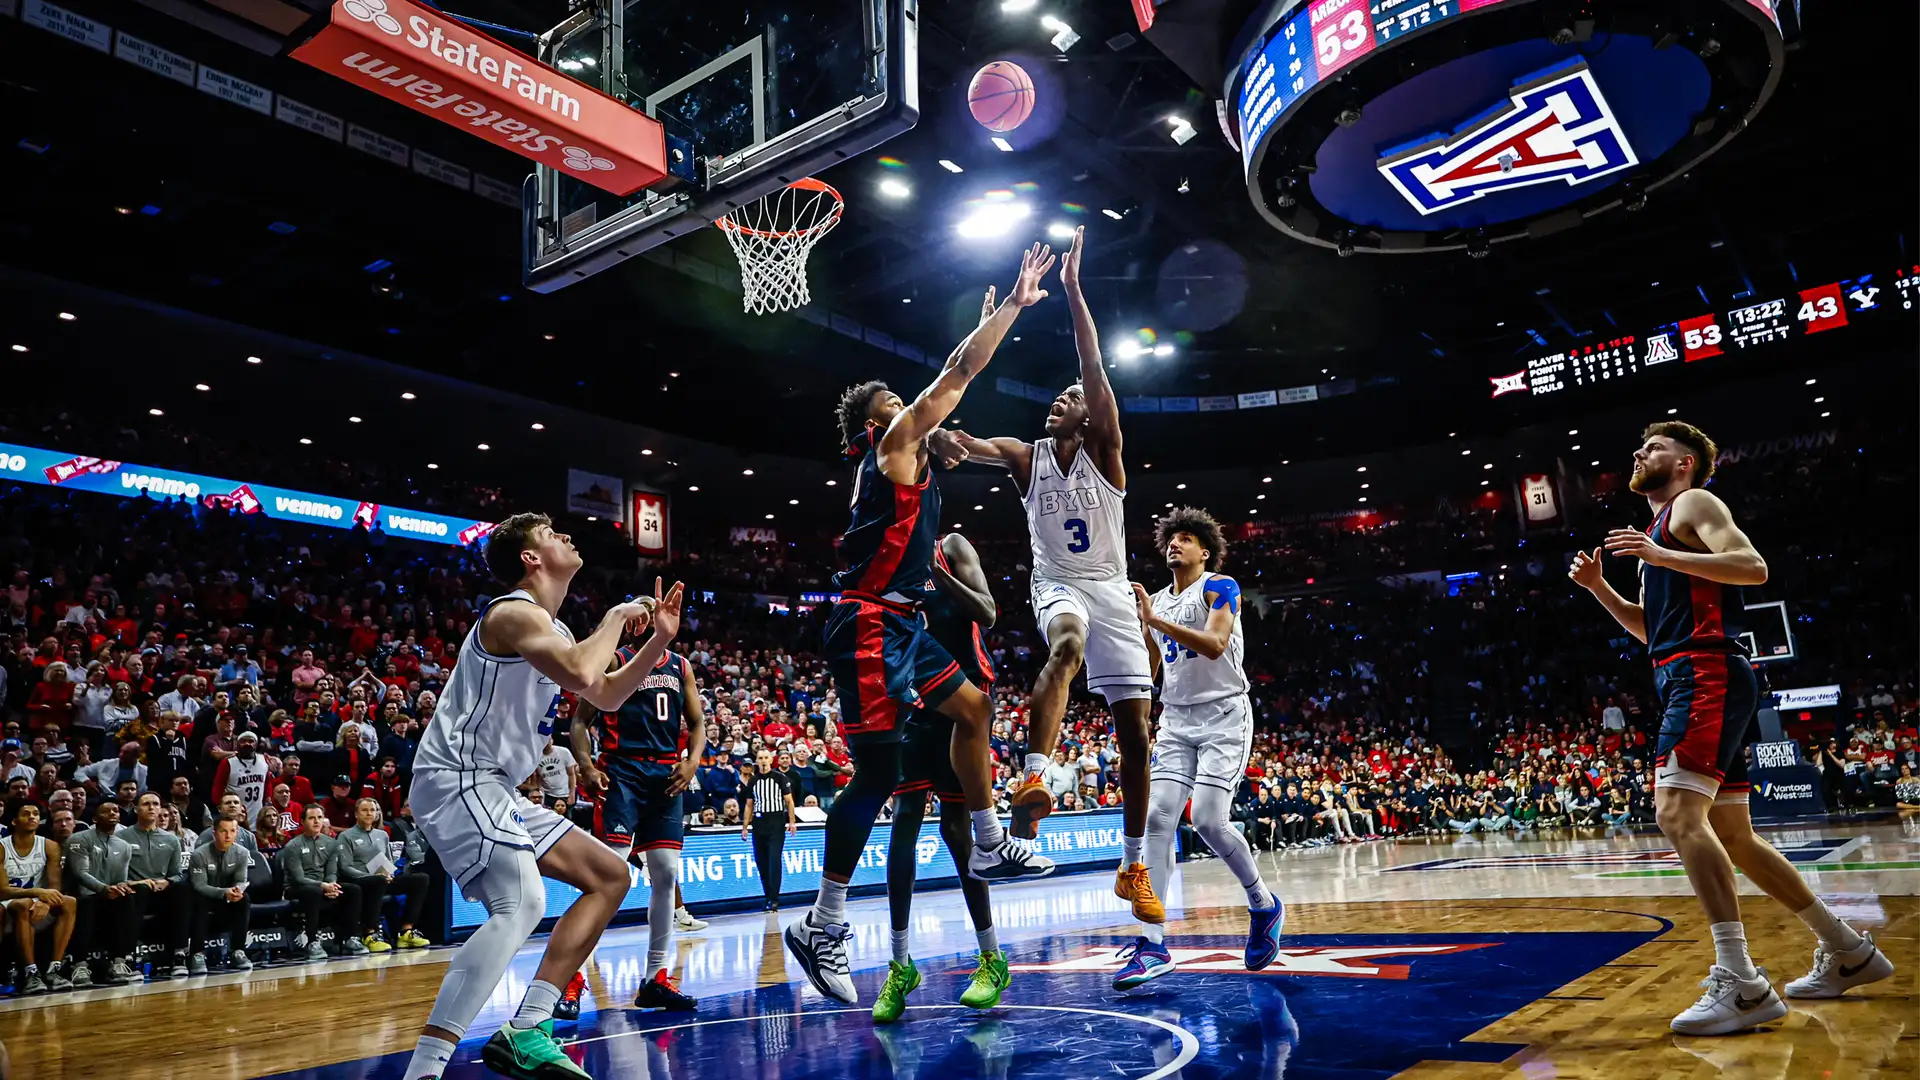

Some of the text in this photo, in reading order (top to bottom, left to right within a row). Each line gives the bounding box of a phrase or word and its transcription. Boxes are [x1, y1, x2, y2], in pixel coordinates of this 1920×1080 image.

[1285, 22, 1296, 40] 13
[1382, 4, 1448, 39] 1 3 2 1
[1317, 9, 1368, 66] 53
[1850, 287, 1880, 309] Y
[1901, 289, 1908, 299] 1
[1902, 300, 1912, 310] 0
[1735, 301, 1784, 325] 13:22
[1797, 296, 1839, 322] 43
[1684, 325, 1723, 350] 53
[1528, 353, 1565, 369] PLAYER
[1529, 362, 1565, 378] POINTS
[1532, 380, 1564, 396] FOULS
[1602, 370, 1610, 379] 0
[121, 471, 200, 498] venmo
[275, 495, 343, 520] venmo
[1040, 486, 1102, 516] BYU
[1533, 492, 1548, 505] 31
[388, 514, 448, 537] venmo
[643, 518, 658, 533] 34
[729, 526, 777, 542] NCAA
[1064, 518, 1091, 553] 3
[656, 692, 670, 721] 0
[1756, 743, 1795, 758] ROCKIN'
[1758, 755, 1796, 768] PROTEIN
[244, 786, 260, 802] 33
[1773, 782, 1812, 794] Vantage
[1774, 791, 1797, 800] West
[1044, 830, 1072, 851] THE
[1074, 821, 1125, 849] WILDCA
[782, 844, 887, 874] WILTS
